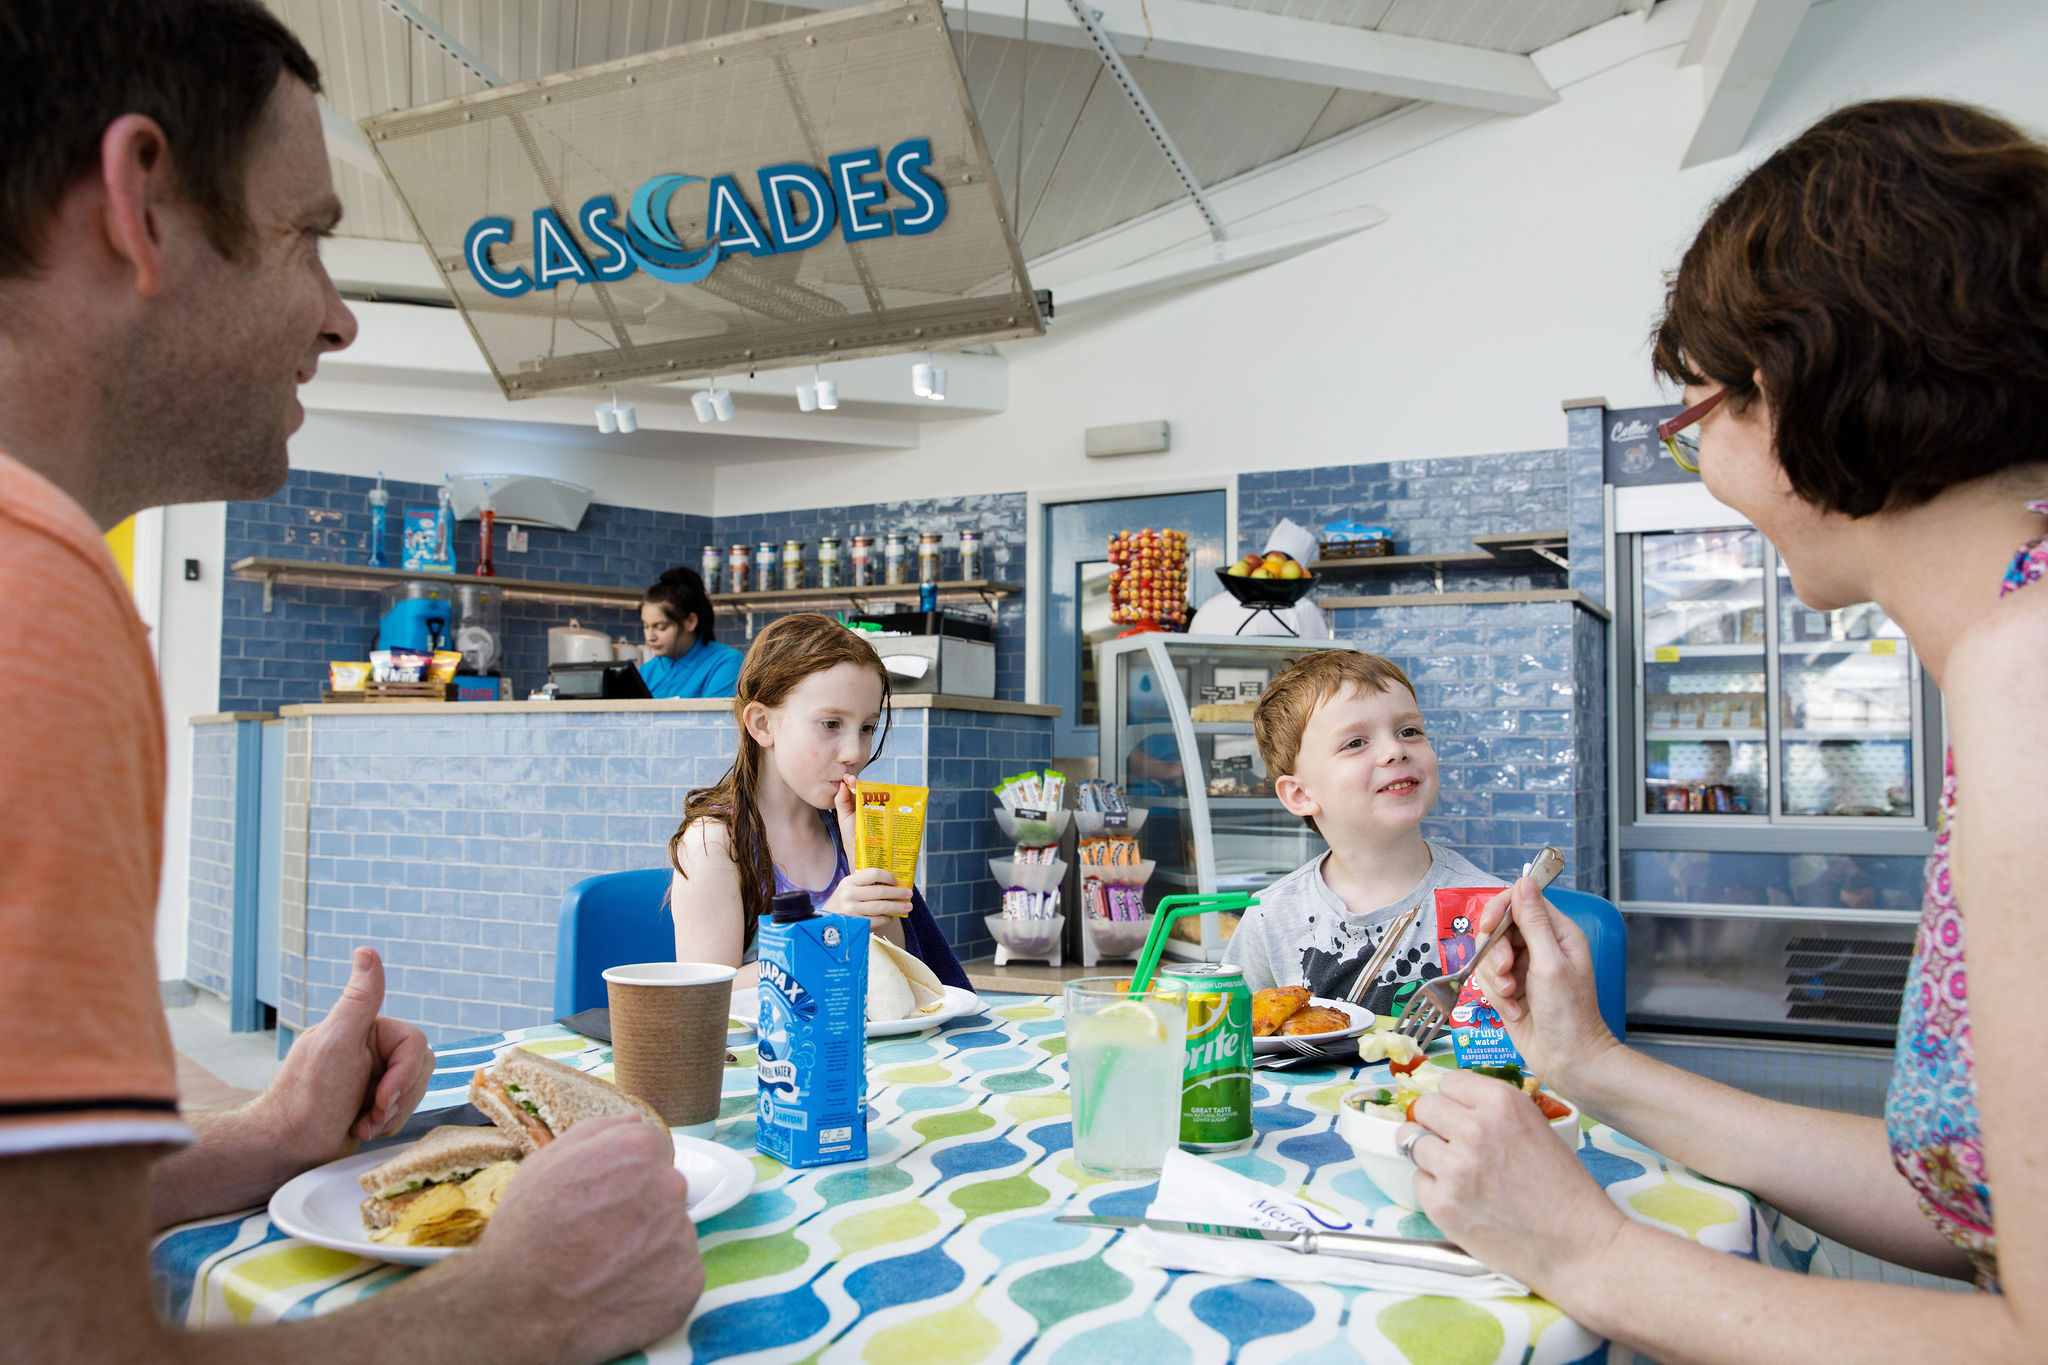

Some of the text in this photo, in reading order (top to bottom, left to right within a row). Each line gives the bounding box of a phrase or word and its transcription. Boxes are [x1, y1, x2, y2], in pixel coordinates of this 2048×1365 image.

[464, 138, 947, 298] CASCADES
[862, 791, 890, 806] pip
[758, 960, 805, 1004] UAPAX
[1183, 1026, 1239, 1071] rite
[1470, 1028, 1504, 1040] fruity
[774, 1065, 792, 1079] WATER
